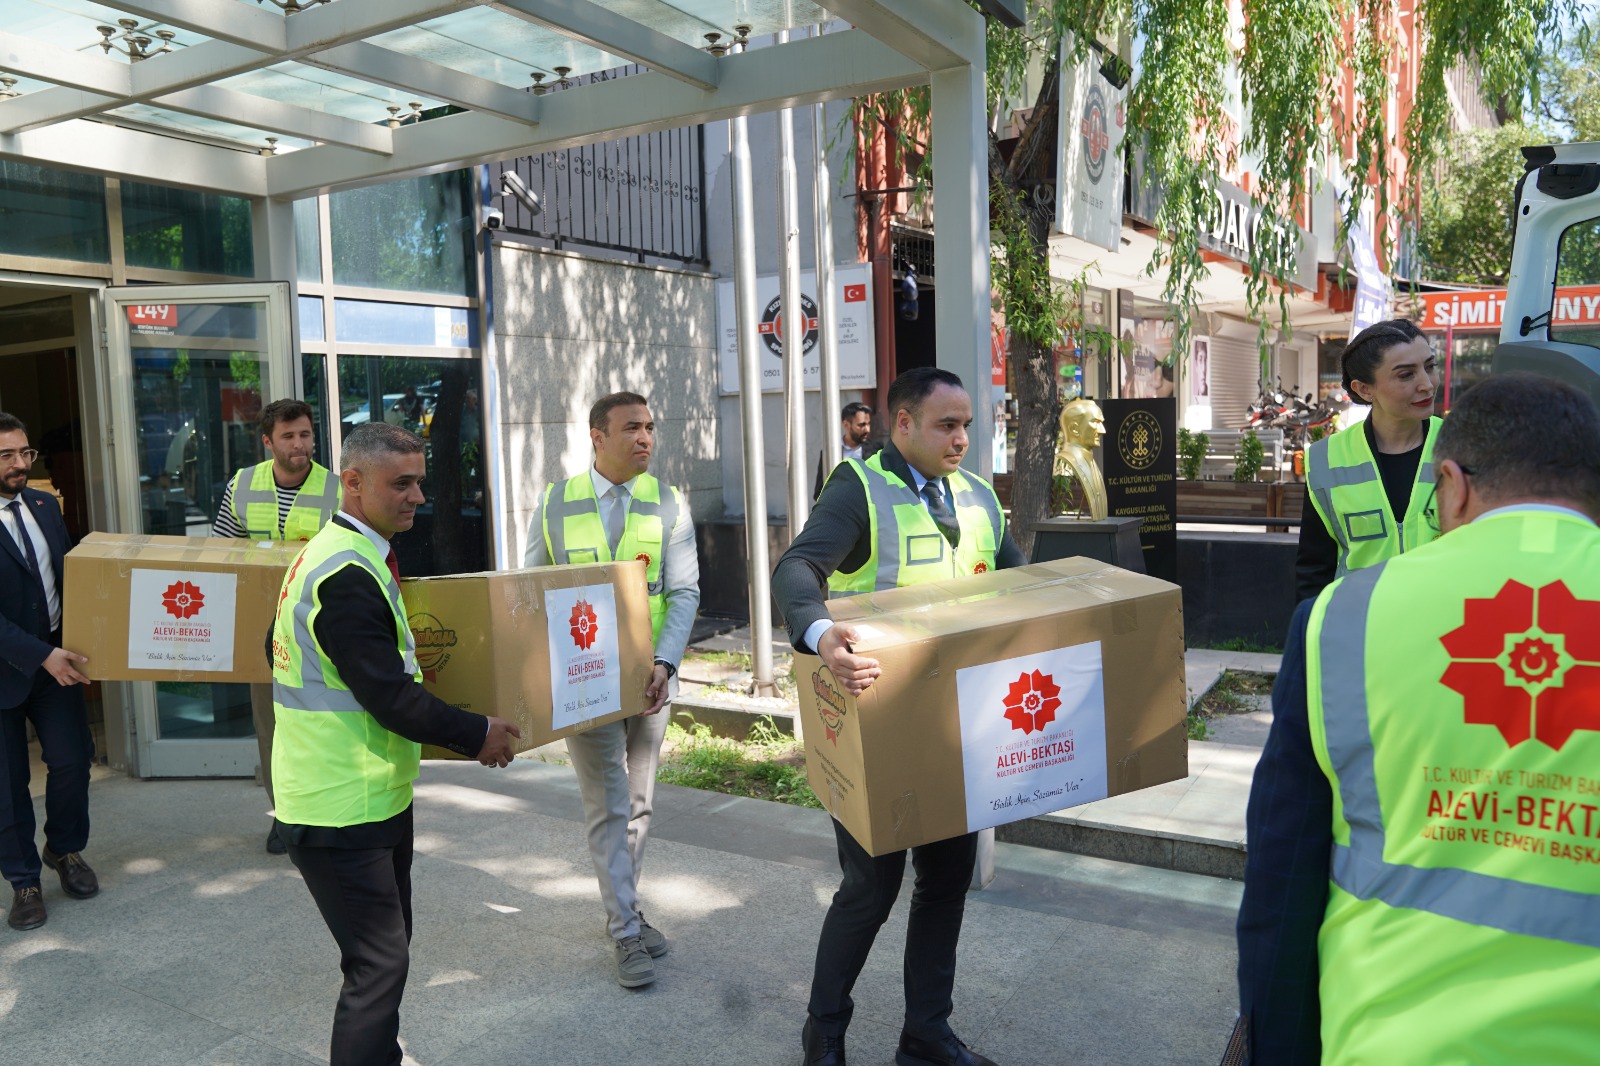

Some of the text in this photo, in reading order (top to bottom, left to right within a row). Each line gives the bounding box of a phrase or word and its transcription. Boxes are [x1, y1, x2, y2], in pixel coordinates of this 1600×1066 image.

[135, 305, 169, 320] 149
[763, 369, 780, 378] 0501
[810, 366, 820, 375] 57
[1119, 473, 1143, 485] KÜLTÜR
[1143, 474, 1150, 483] VE
[1151, 473, 1172, 481] TURİZM
[1125, 485, 1156, 494] BAKANLIĞI
[1115, 504, 1166, 515] KAYGUSUZ ABDAL
[1142, 514, 1170, 524] EKTAŞİLİK
[1024, 739, 1031, 747] VE
[997, 739, 1074, 769] ALEVİ-BEKTAŞİ
[1017, 766, 1024, 774] VE
[1423, 766, 1447, 783] T.C.
[1496, 769, 1514, 786] VE
[1471, 828, 1489, 844] VE
